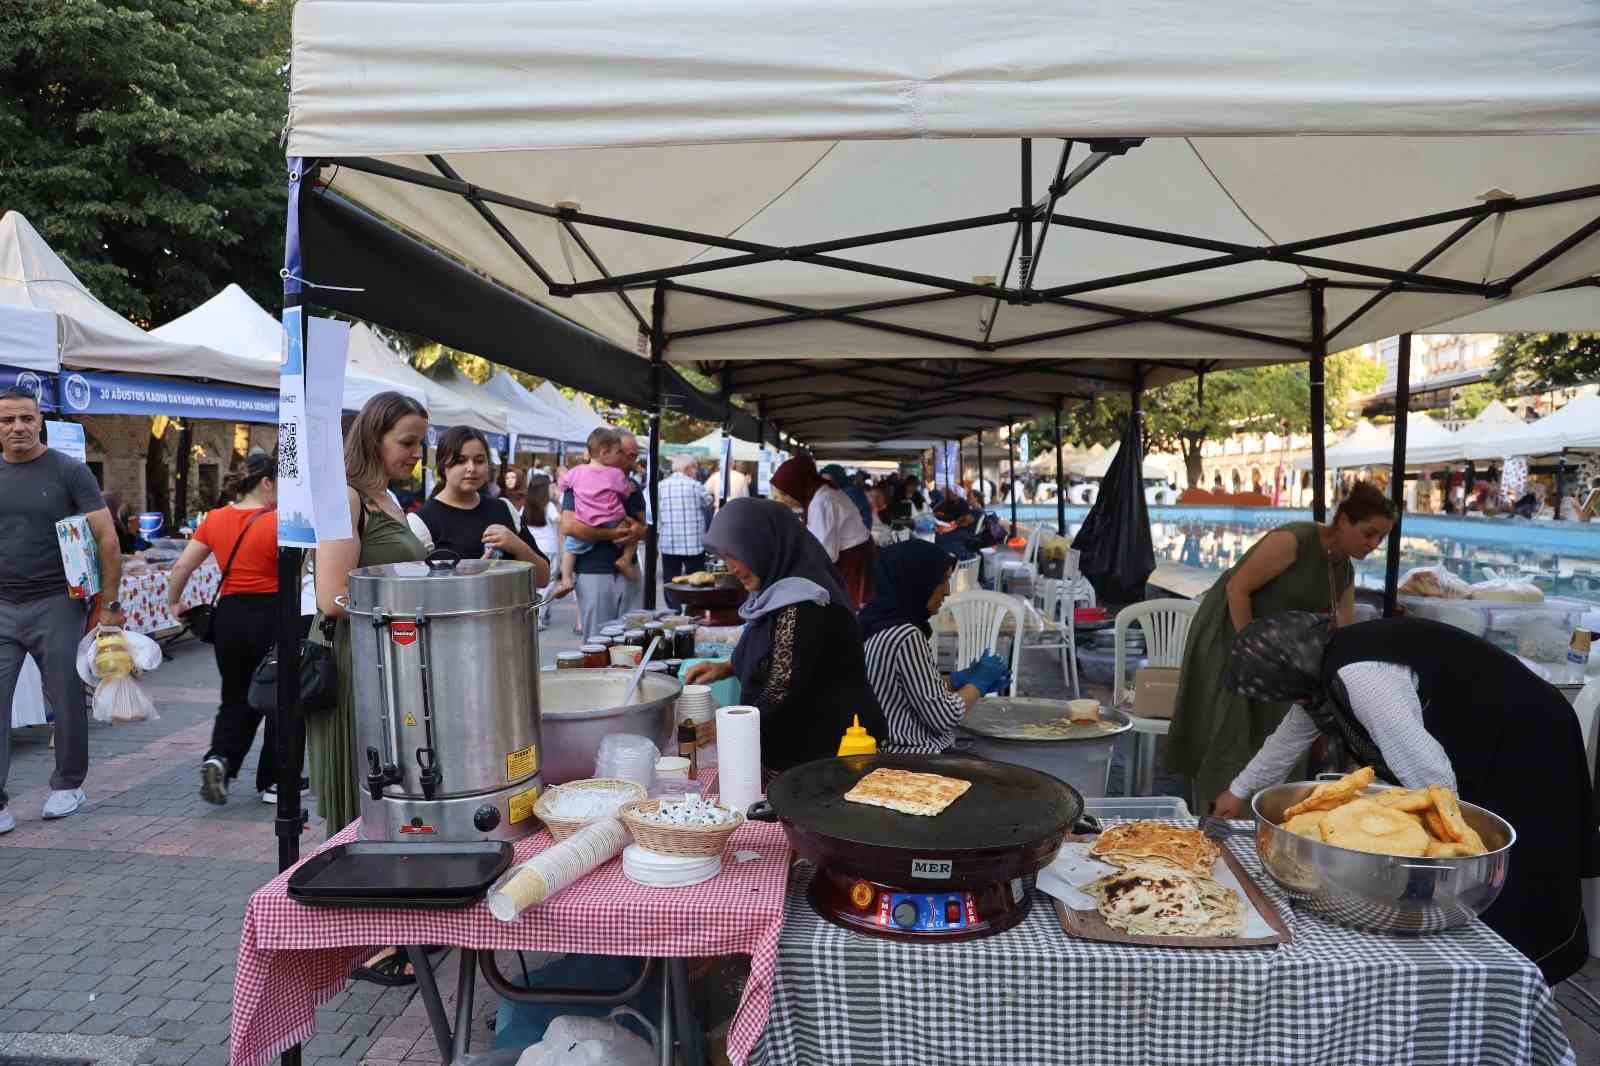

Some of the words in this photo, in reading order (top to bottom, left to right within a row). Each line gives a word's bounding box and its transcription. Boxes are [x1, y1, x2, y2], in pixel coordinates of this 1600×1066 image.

[101, 389, 109, 400] 30
[914, 862, 951, 873] MER
[966, 901, 976, 922] MER
